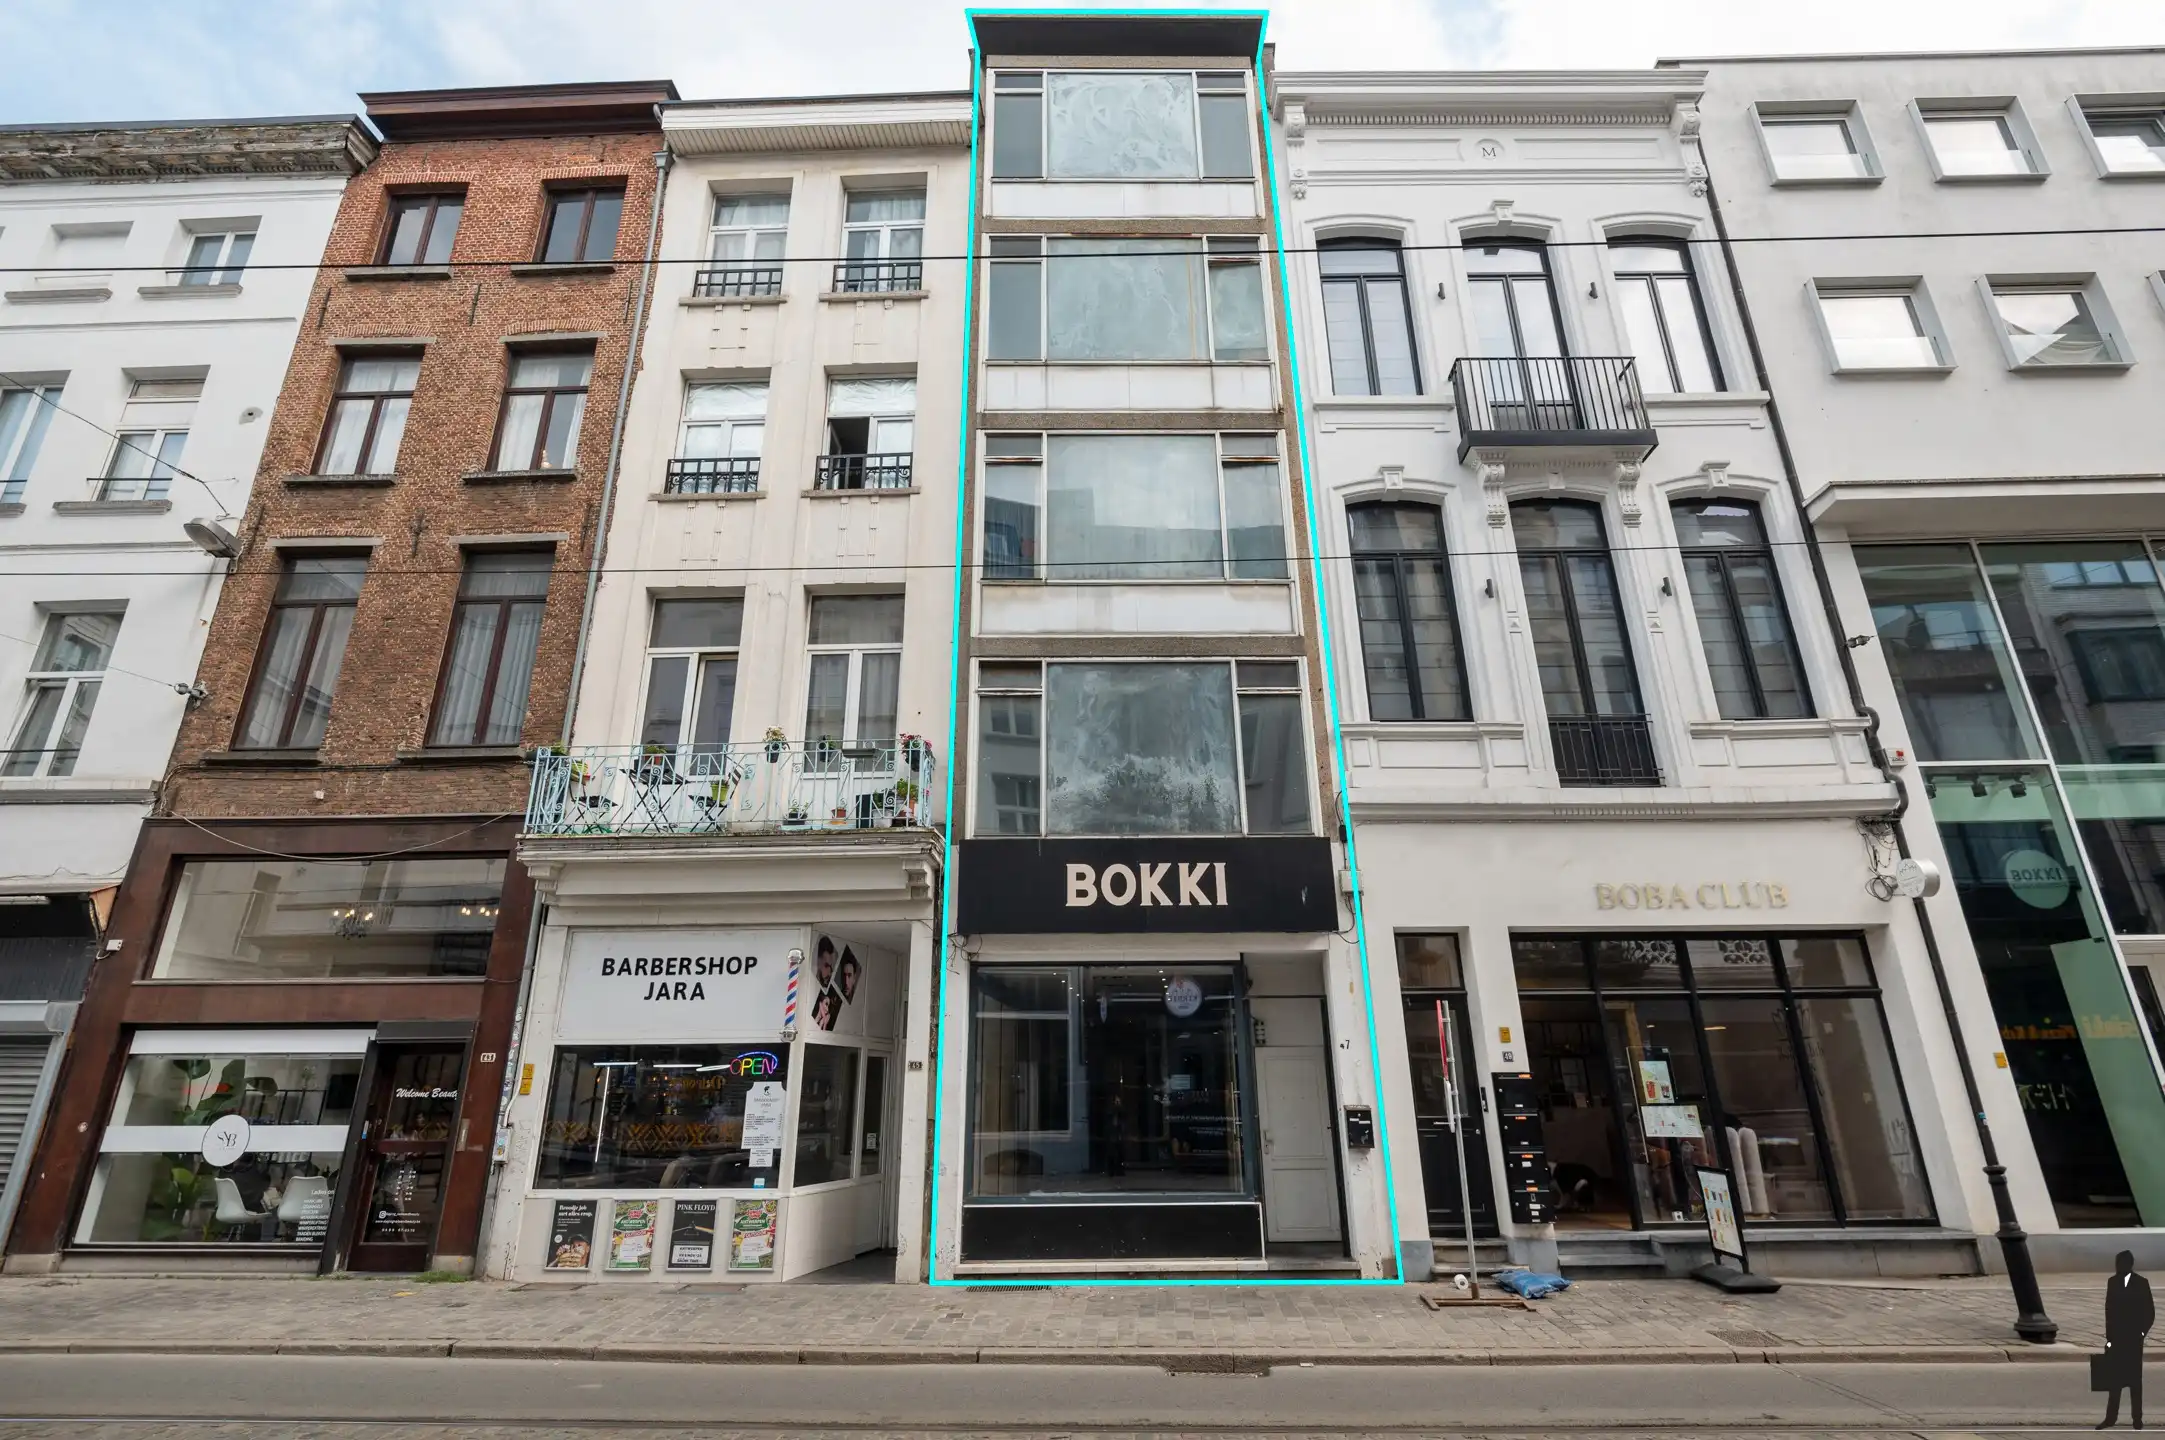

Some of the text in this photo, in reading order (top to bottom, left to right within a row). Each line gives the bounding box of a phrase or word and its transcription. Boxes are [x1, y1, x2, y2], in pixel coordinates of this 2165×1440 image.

[1482, 147, 1496, 157] M
[2010, 867, 2063, 881] BOKKI
[1065, 862, 1229, 907] BOKKI
[1595, 880, 1790, 911] BOBA CLUB
[601, 956, 758, 976] BARBERSHOP
[643, 981, 705, 1001] JARA
[1504, 1053, 1513, 1061] 49
[729, 1058, 775, 1076] OPEN
[396, 1088, 430, 1098] Welcome
[677, 1203, 716, 1211] PINK FLOYD
